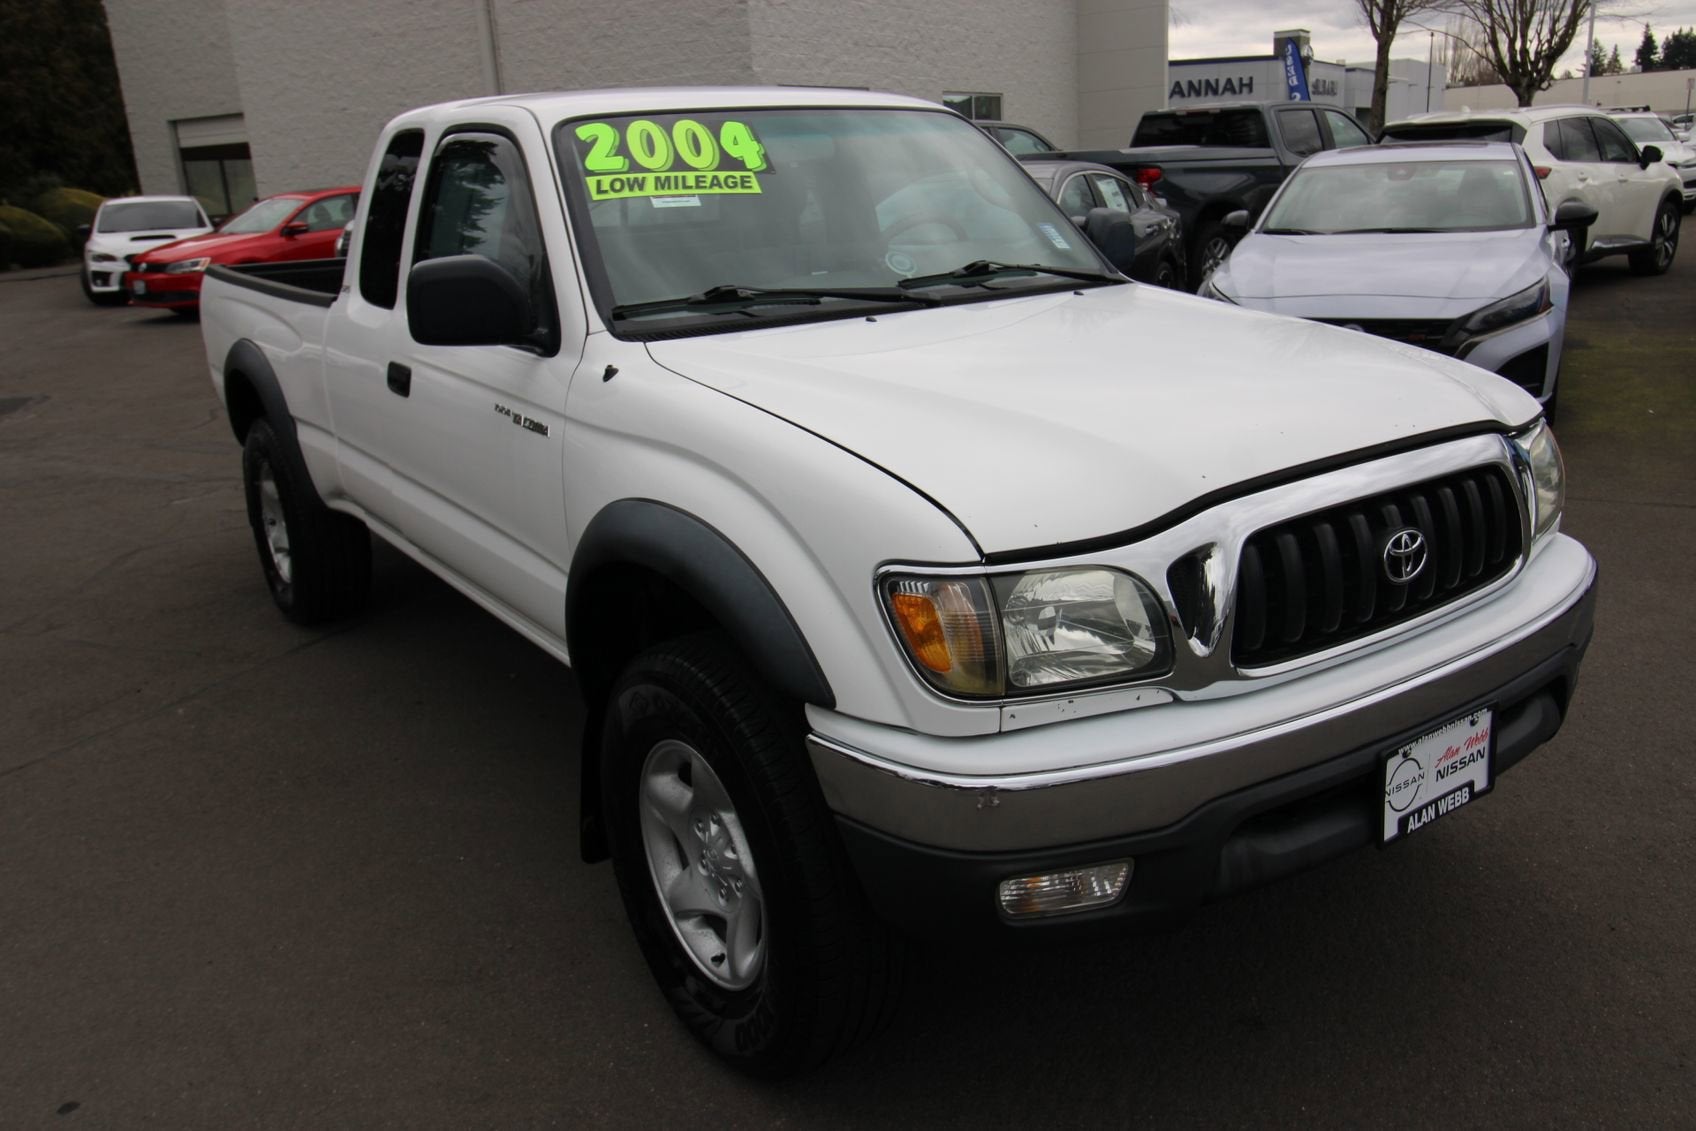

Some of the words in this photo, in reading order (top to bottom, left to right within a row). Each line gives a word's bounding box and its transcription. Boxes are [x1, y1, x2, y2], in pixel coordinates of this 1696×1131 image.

[575, 119, 767, 172] 2004
[596, 177, 646, 195] LOW
[654, 175, 753, 191] MILEAGE
[1435, 746, 1460, 769] Alan
[1464, 728, 1489, 752] Webb
[1436, 747, 1486, 782] NISSAN
[1385, 771, 1425, 796] NISSAN
[1407, 804, 1436, 834] ALAN
[1438, 787, 1470, 816] WEBB
